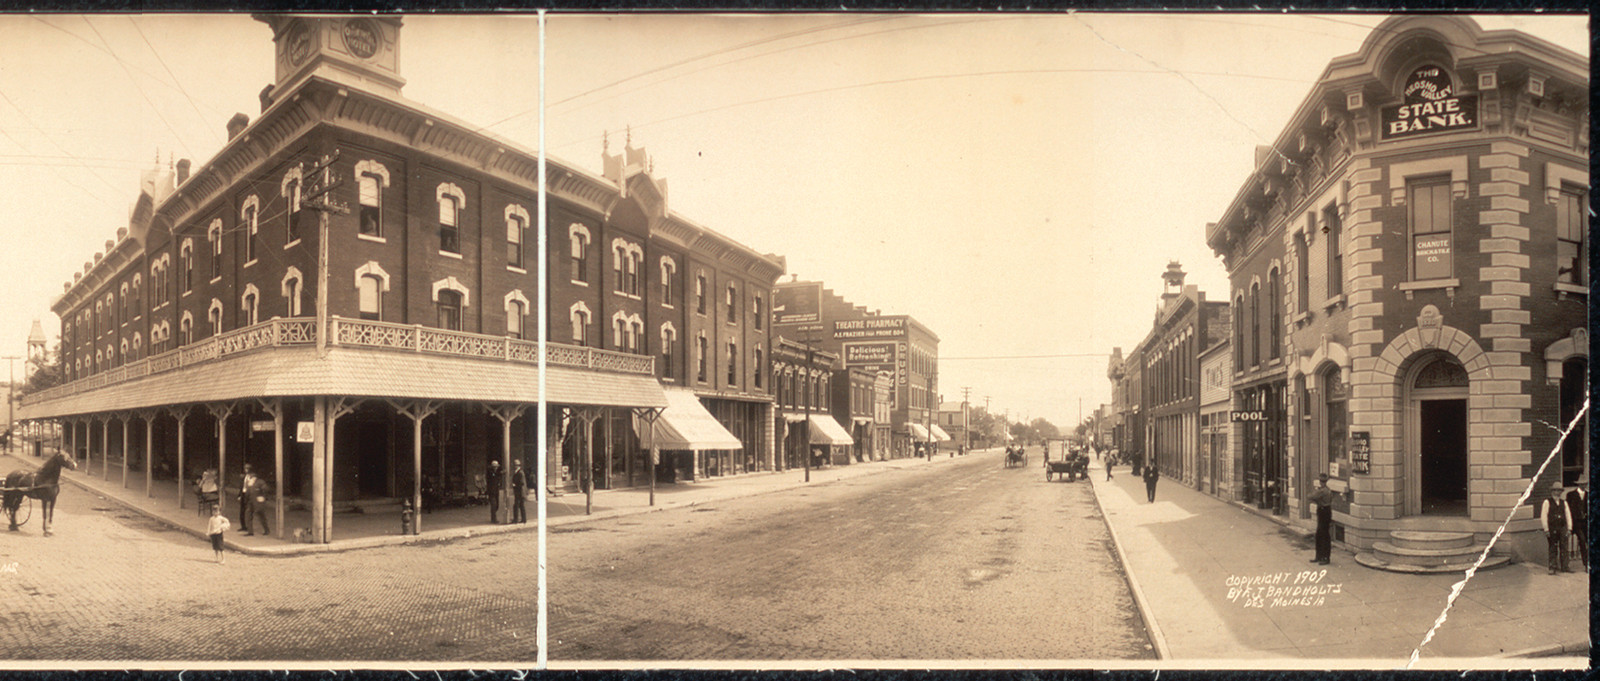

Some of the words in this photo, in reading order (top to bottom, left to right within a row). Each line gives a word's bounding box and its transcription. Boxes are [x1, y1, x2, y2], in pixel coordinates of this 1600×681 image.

[1416, 68, 1439, 78] THE
[1405, 80, 1438, 96] NEOSHO
[1421, 85, 1452, 100] VALLEY
[1398, 98, 1460, 119] STATE
[1389, 112, 1472, 134] BANK.
[1417, 240, 1448, 249] CHANUTE
[835, 320, 865, 330] THEATRE
[866, 319, 904, 329] PHARMACY
[899, 344, 907, 384] DRUGS
